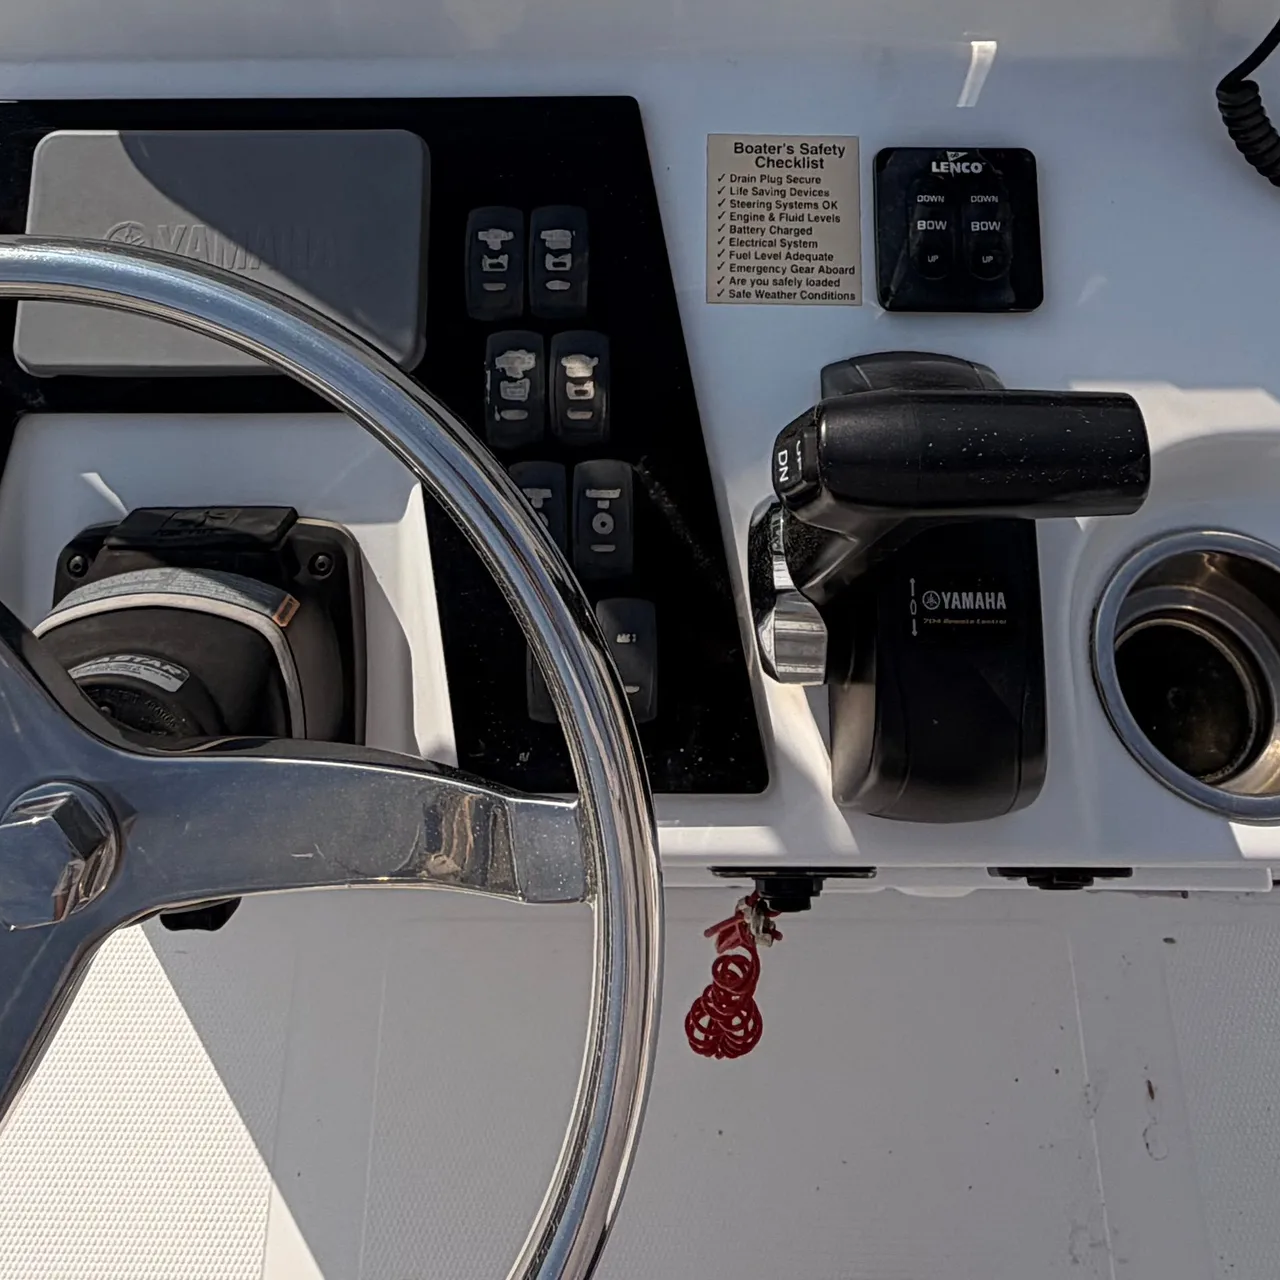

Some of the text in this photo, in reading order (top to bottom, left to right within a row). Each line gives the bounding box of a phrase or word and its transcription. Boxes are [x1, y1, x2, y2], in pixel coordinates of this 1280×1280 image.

[734, 142, 845, 158] Boater's Safety
[755, 157, 824, 169] Checklist
[931, 160, 983, 175] LENCO
[730, 174, 821, 185] Drain Plug Secure
[730, 187, 830, 198] Life Saving Devices
[916, 195, 999, 203] DOWN DOWN
[730, 200, 838, 211] Steering Systems OK
[730, 212, 840, 223] Engine & Fluid Levels
[729, 225, 813, 237] Battery Charged
[917, 220, 1001, 231] BOW BOW
[157, 223, 337, 271] YAMAHA
[729, 238, 818, 249] Electrical System
[729, 251, 834, 262] Fuel Level Adequate
[927, 255, 994, 264] UP UP
[729, 264, 855, 275] Emergency Gear Aboard
[729, 277, 840, 288] Are you safely loaded
[729, 290, 855, 300] Safe Weather Conditions
[777, 449, 789, 483] DN
[942, 591, 1007, 609] YAMAHA
